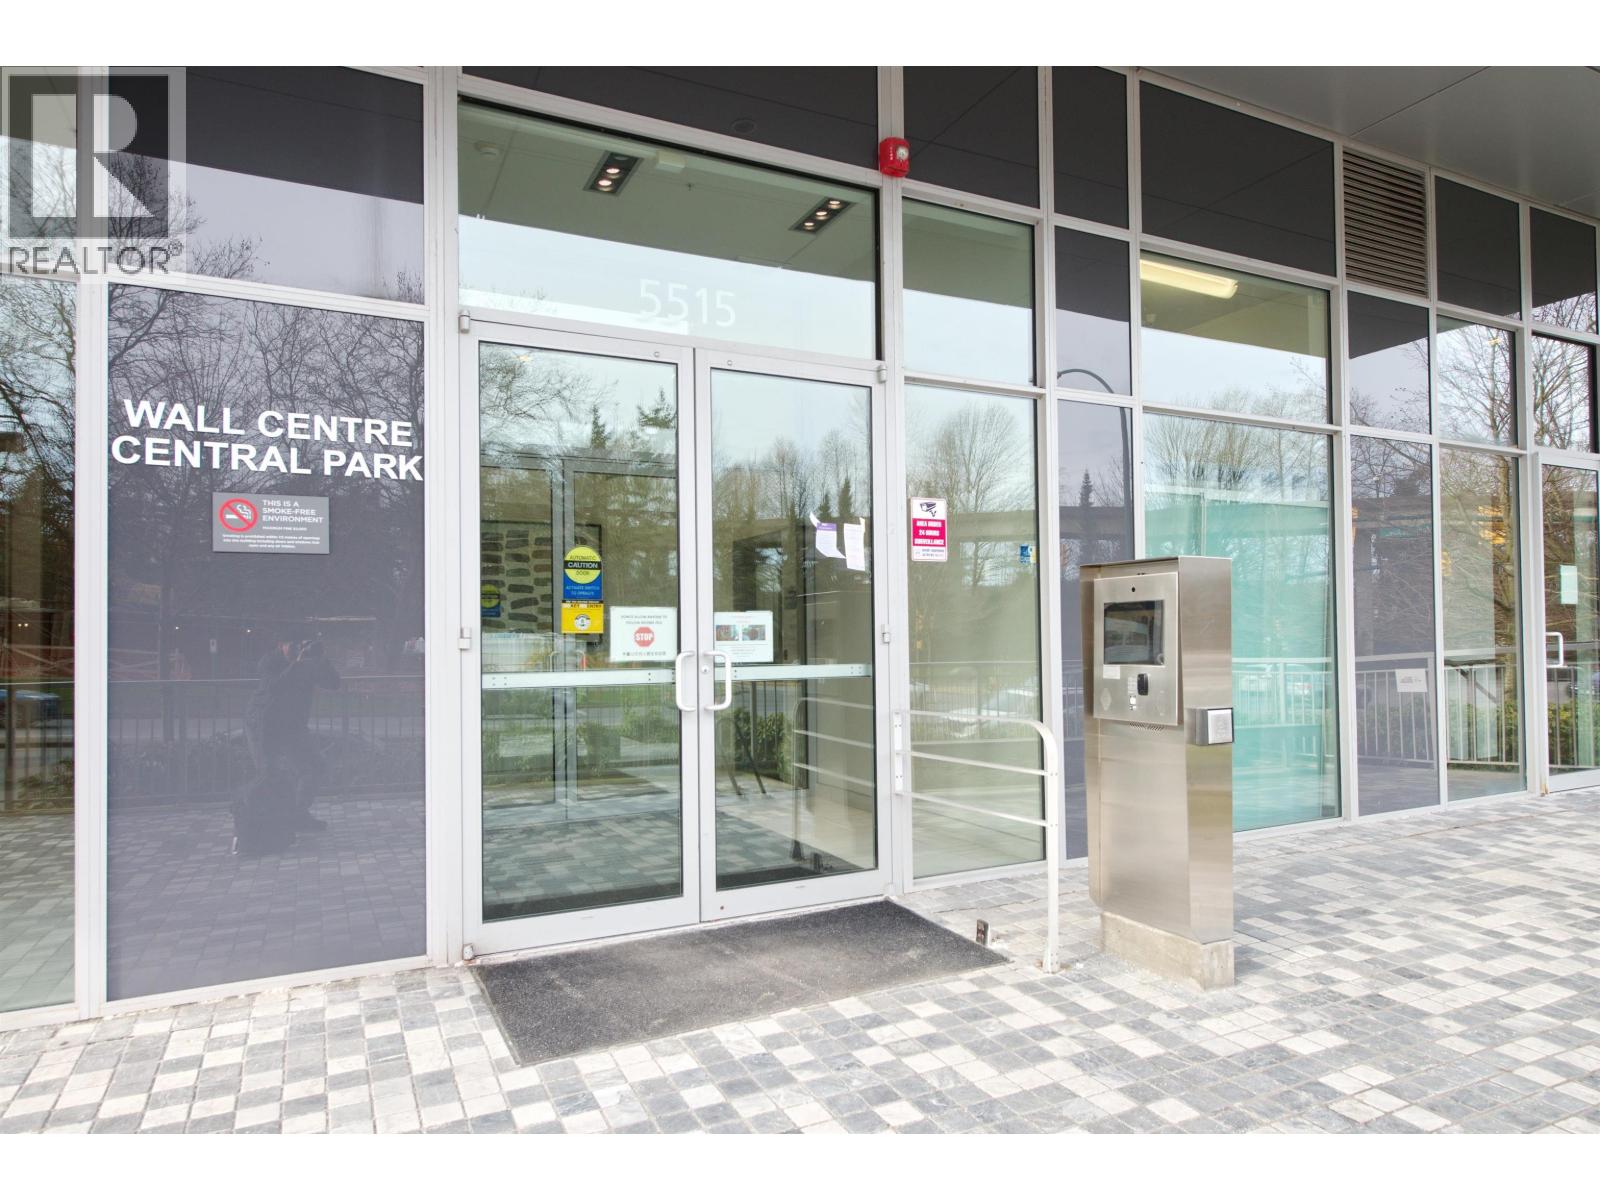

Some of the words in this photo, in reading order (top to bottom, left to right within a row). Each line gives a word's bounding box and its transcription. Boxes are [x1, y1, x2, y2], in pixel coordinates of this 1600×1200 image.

[640, 278, 736, 327] 5515
[123, 399, 245, 435] WALL
[257, 410, 413, 447] CENTRE
[111, 435, 312, 475] CENTRAL
[323, 450, 424, 481] PARK
[263, 499, 281, 507] THIS
[263, 507, 317, 516] SMOKE-FREE
[263, 515, 324, 524] ENVIRONMENT
[635, 632, 653, 641] STOP
